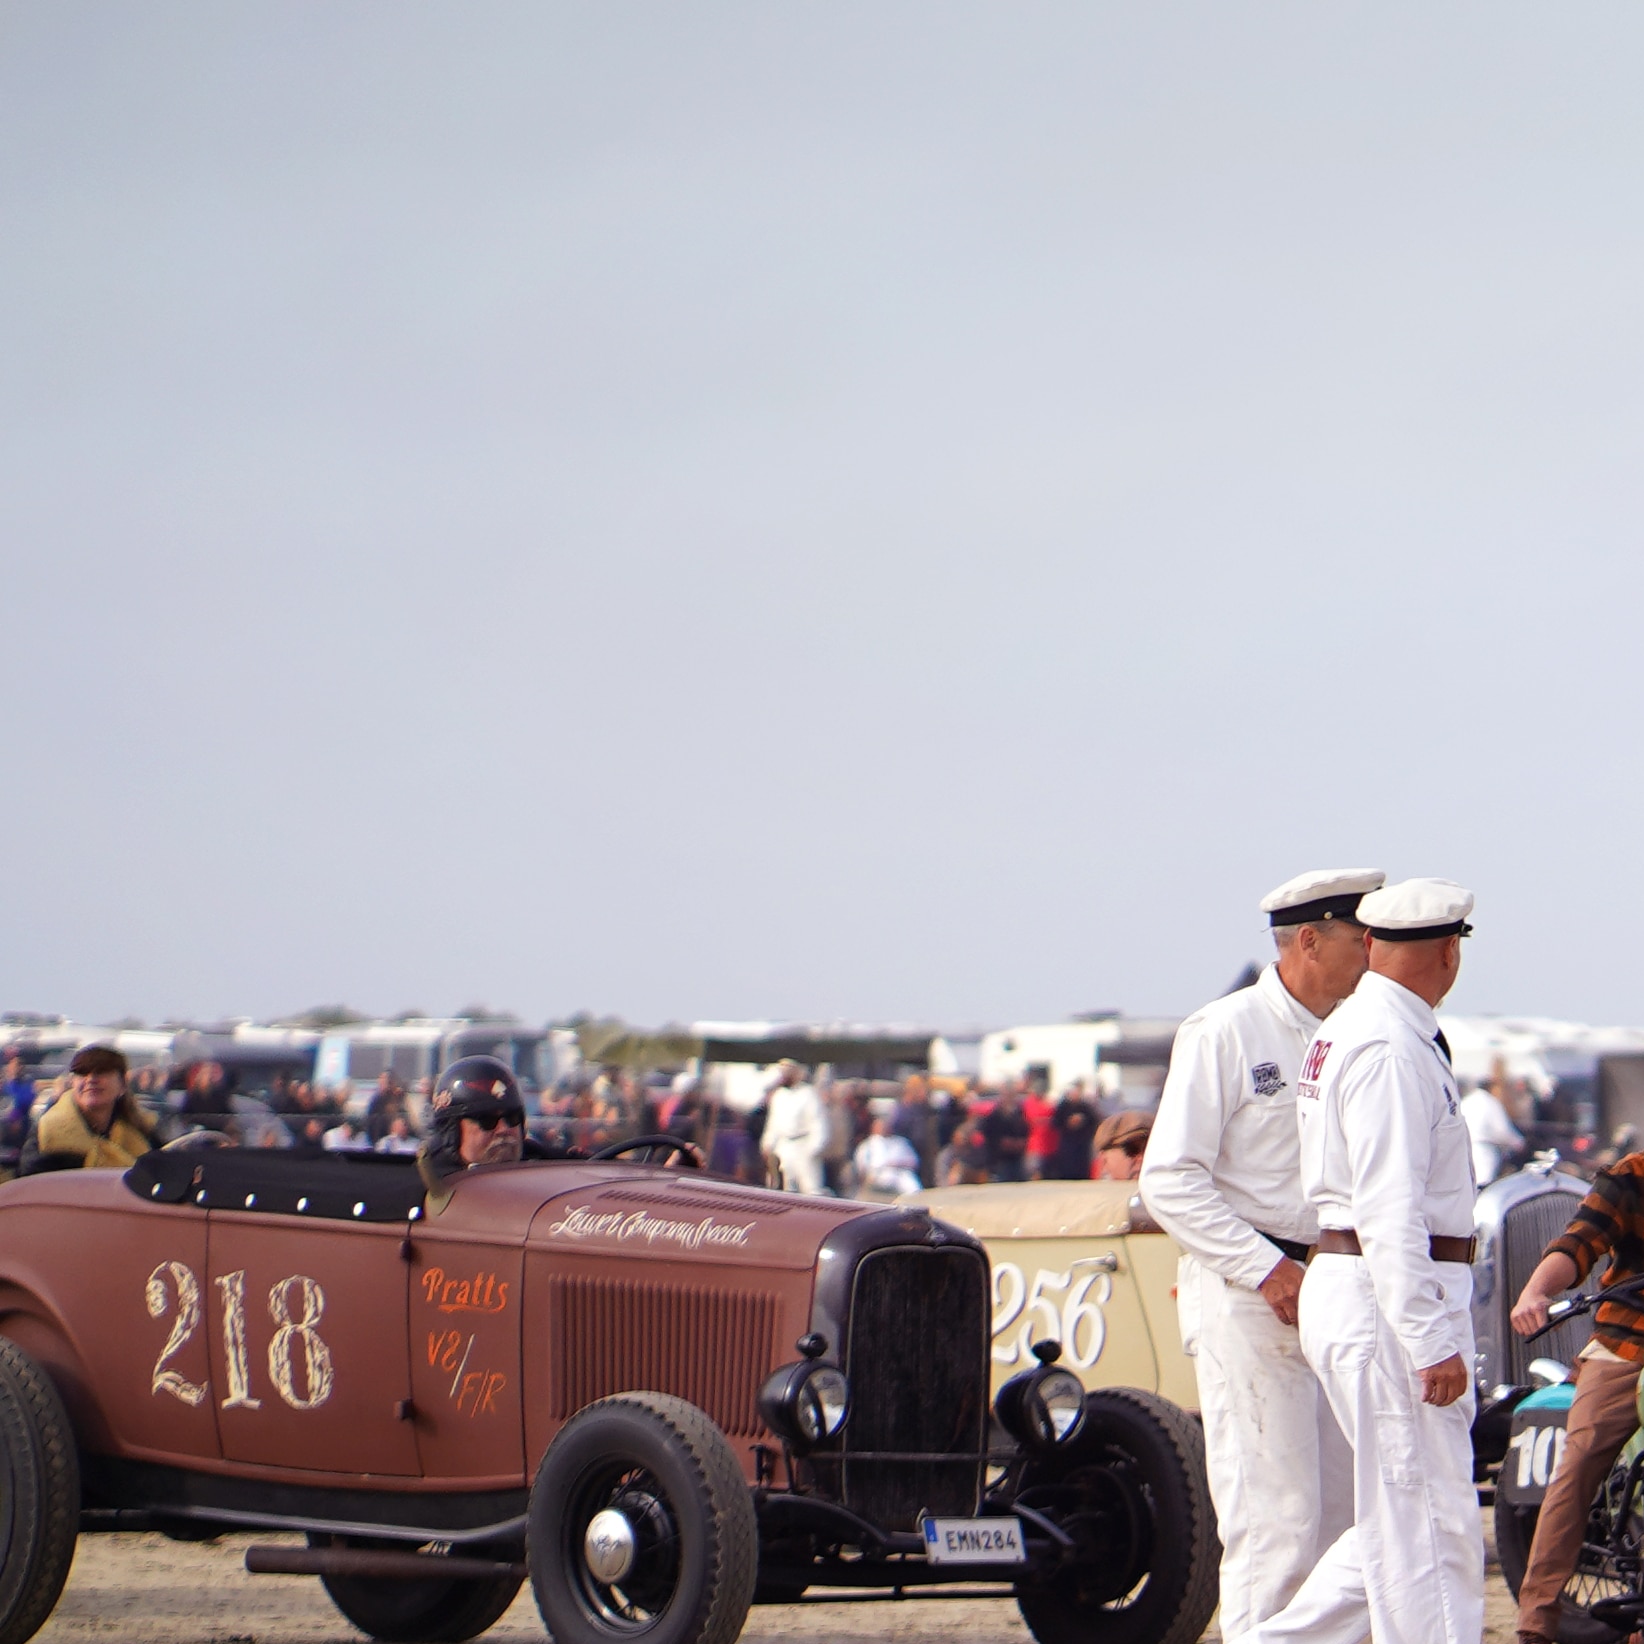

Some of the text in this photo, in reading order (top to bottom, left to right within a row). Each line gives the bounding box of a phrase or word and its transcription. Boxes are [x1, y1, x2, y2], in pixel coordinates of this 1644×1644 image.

[421, 1267, 510, 1313] Pratts
[992, 1262, 1113, 1369] 256
[145, 1261, 335, 1410] 218
[945, 1529, 1017, 1553] EMN284
